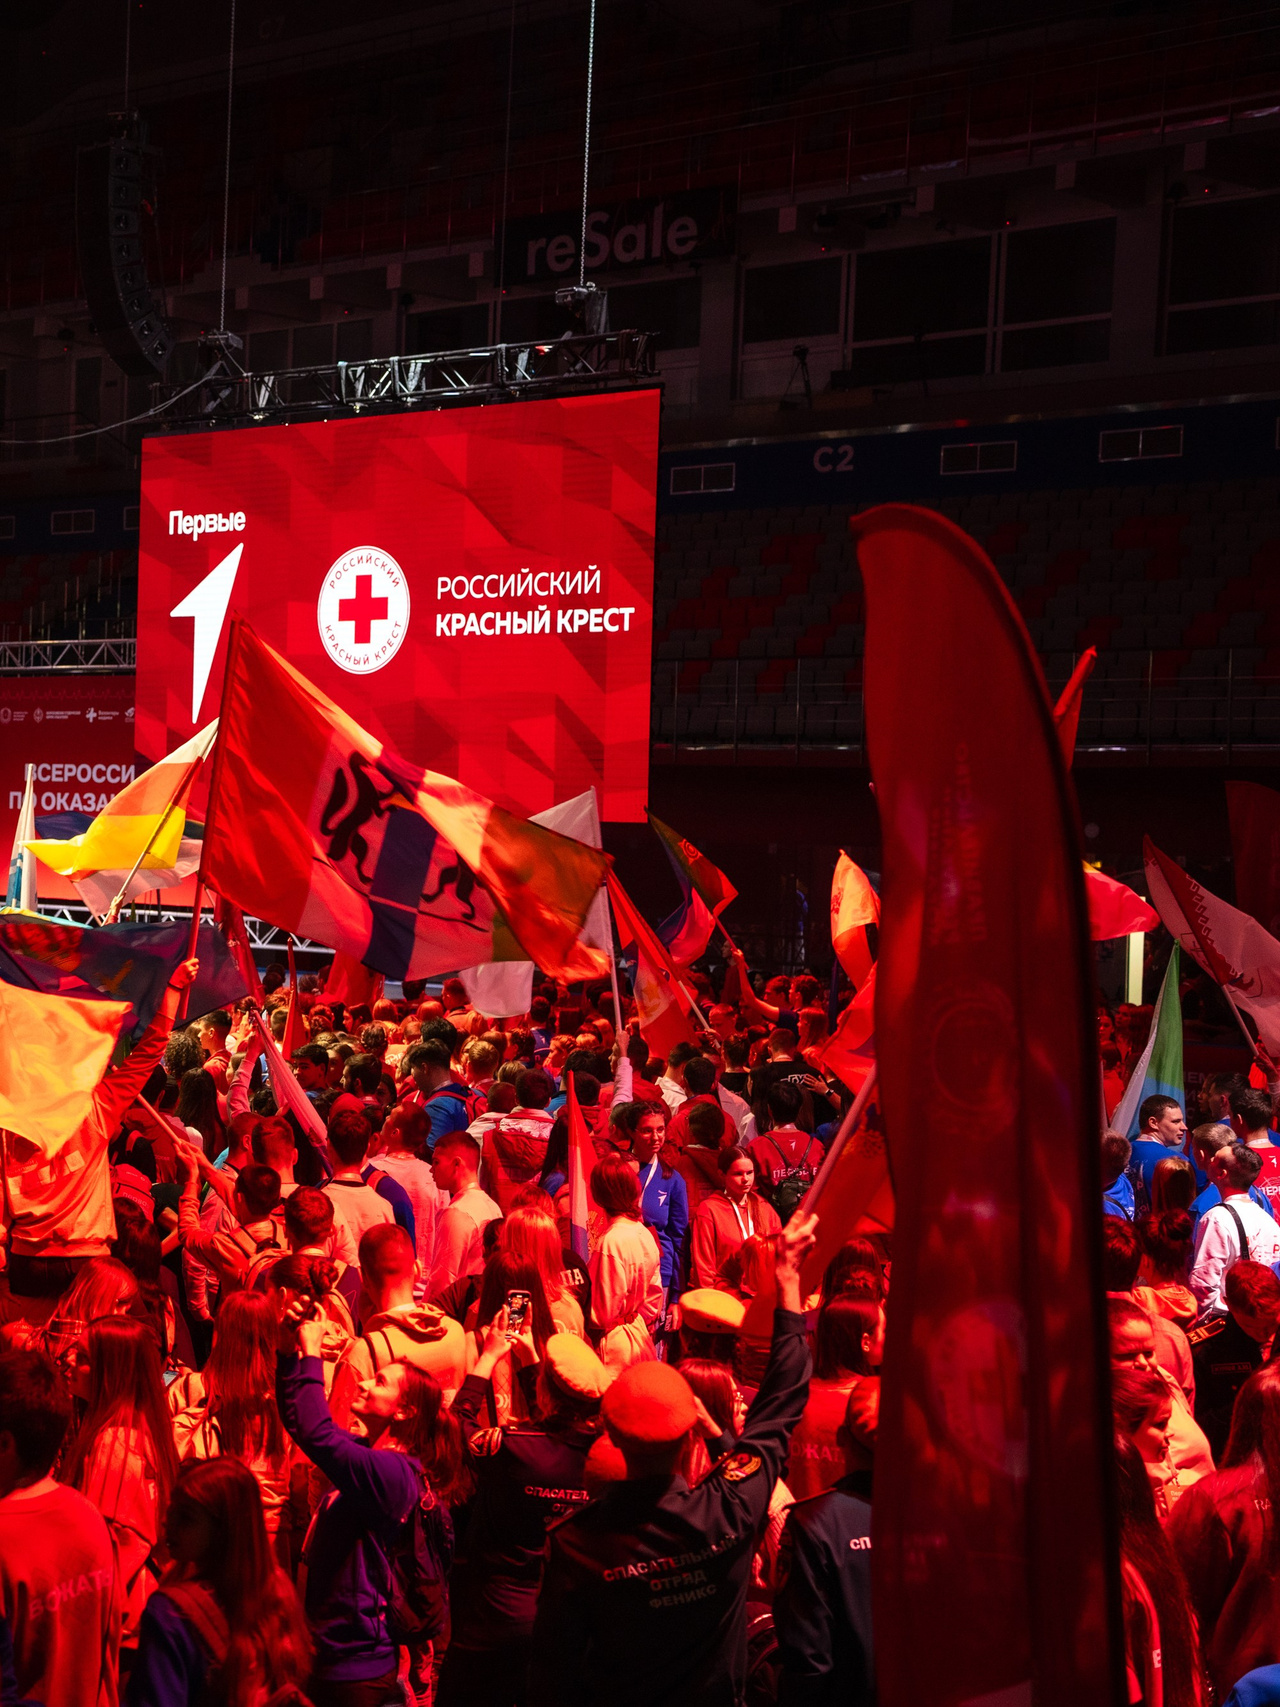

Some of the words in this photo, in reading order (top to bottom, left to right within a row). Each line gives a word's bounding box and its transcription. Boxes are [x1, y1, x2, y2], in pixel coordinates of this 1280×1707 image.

[526, 203, 699, 276] reSale
[168, 509, 247, 541] Первые
[437, 564, 601, 600] РОССИЙСКИЙ
[435, 604, 551, 637] КРАСНЫЙ
[556, 607, 636, 634] КРЕСТ
[40, 791, 116, 812] ОКАЗА
[524, 1485, 590, 1501] СПАСАТЕЛ
[603, 1534, 738, 1582] СПАСАТЕЛЬНЫЙ
[649, 1569, 708, 1593] ОТРЯД
[649, 1583, 718, 1609] ФЕНИКС
